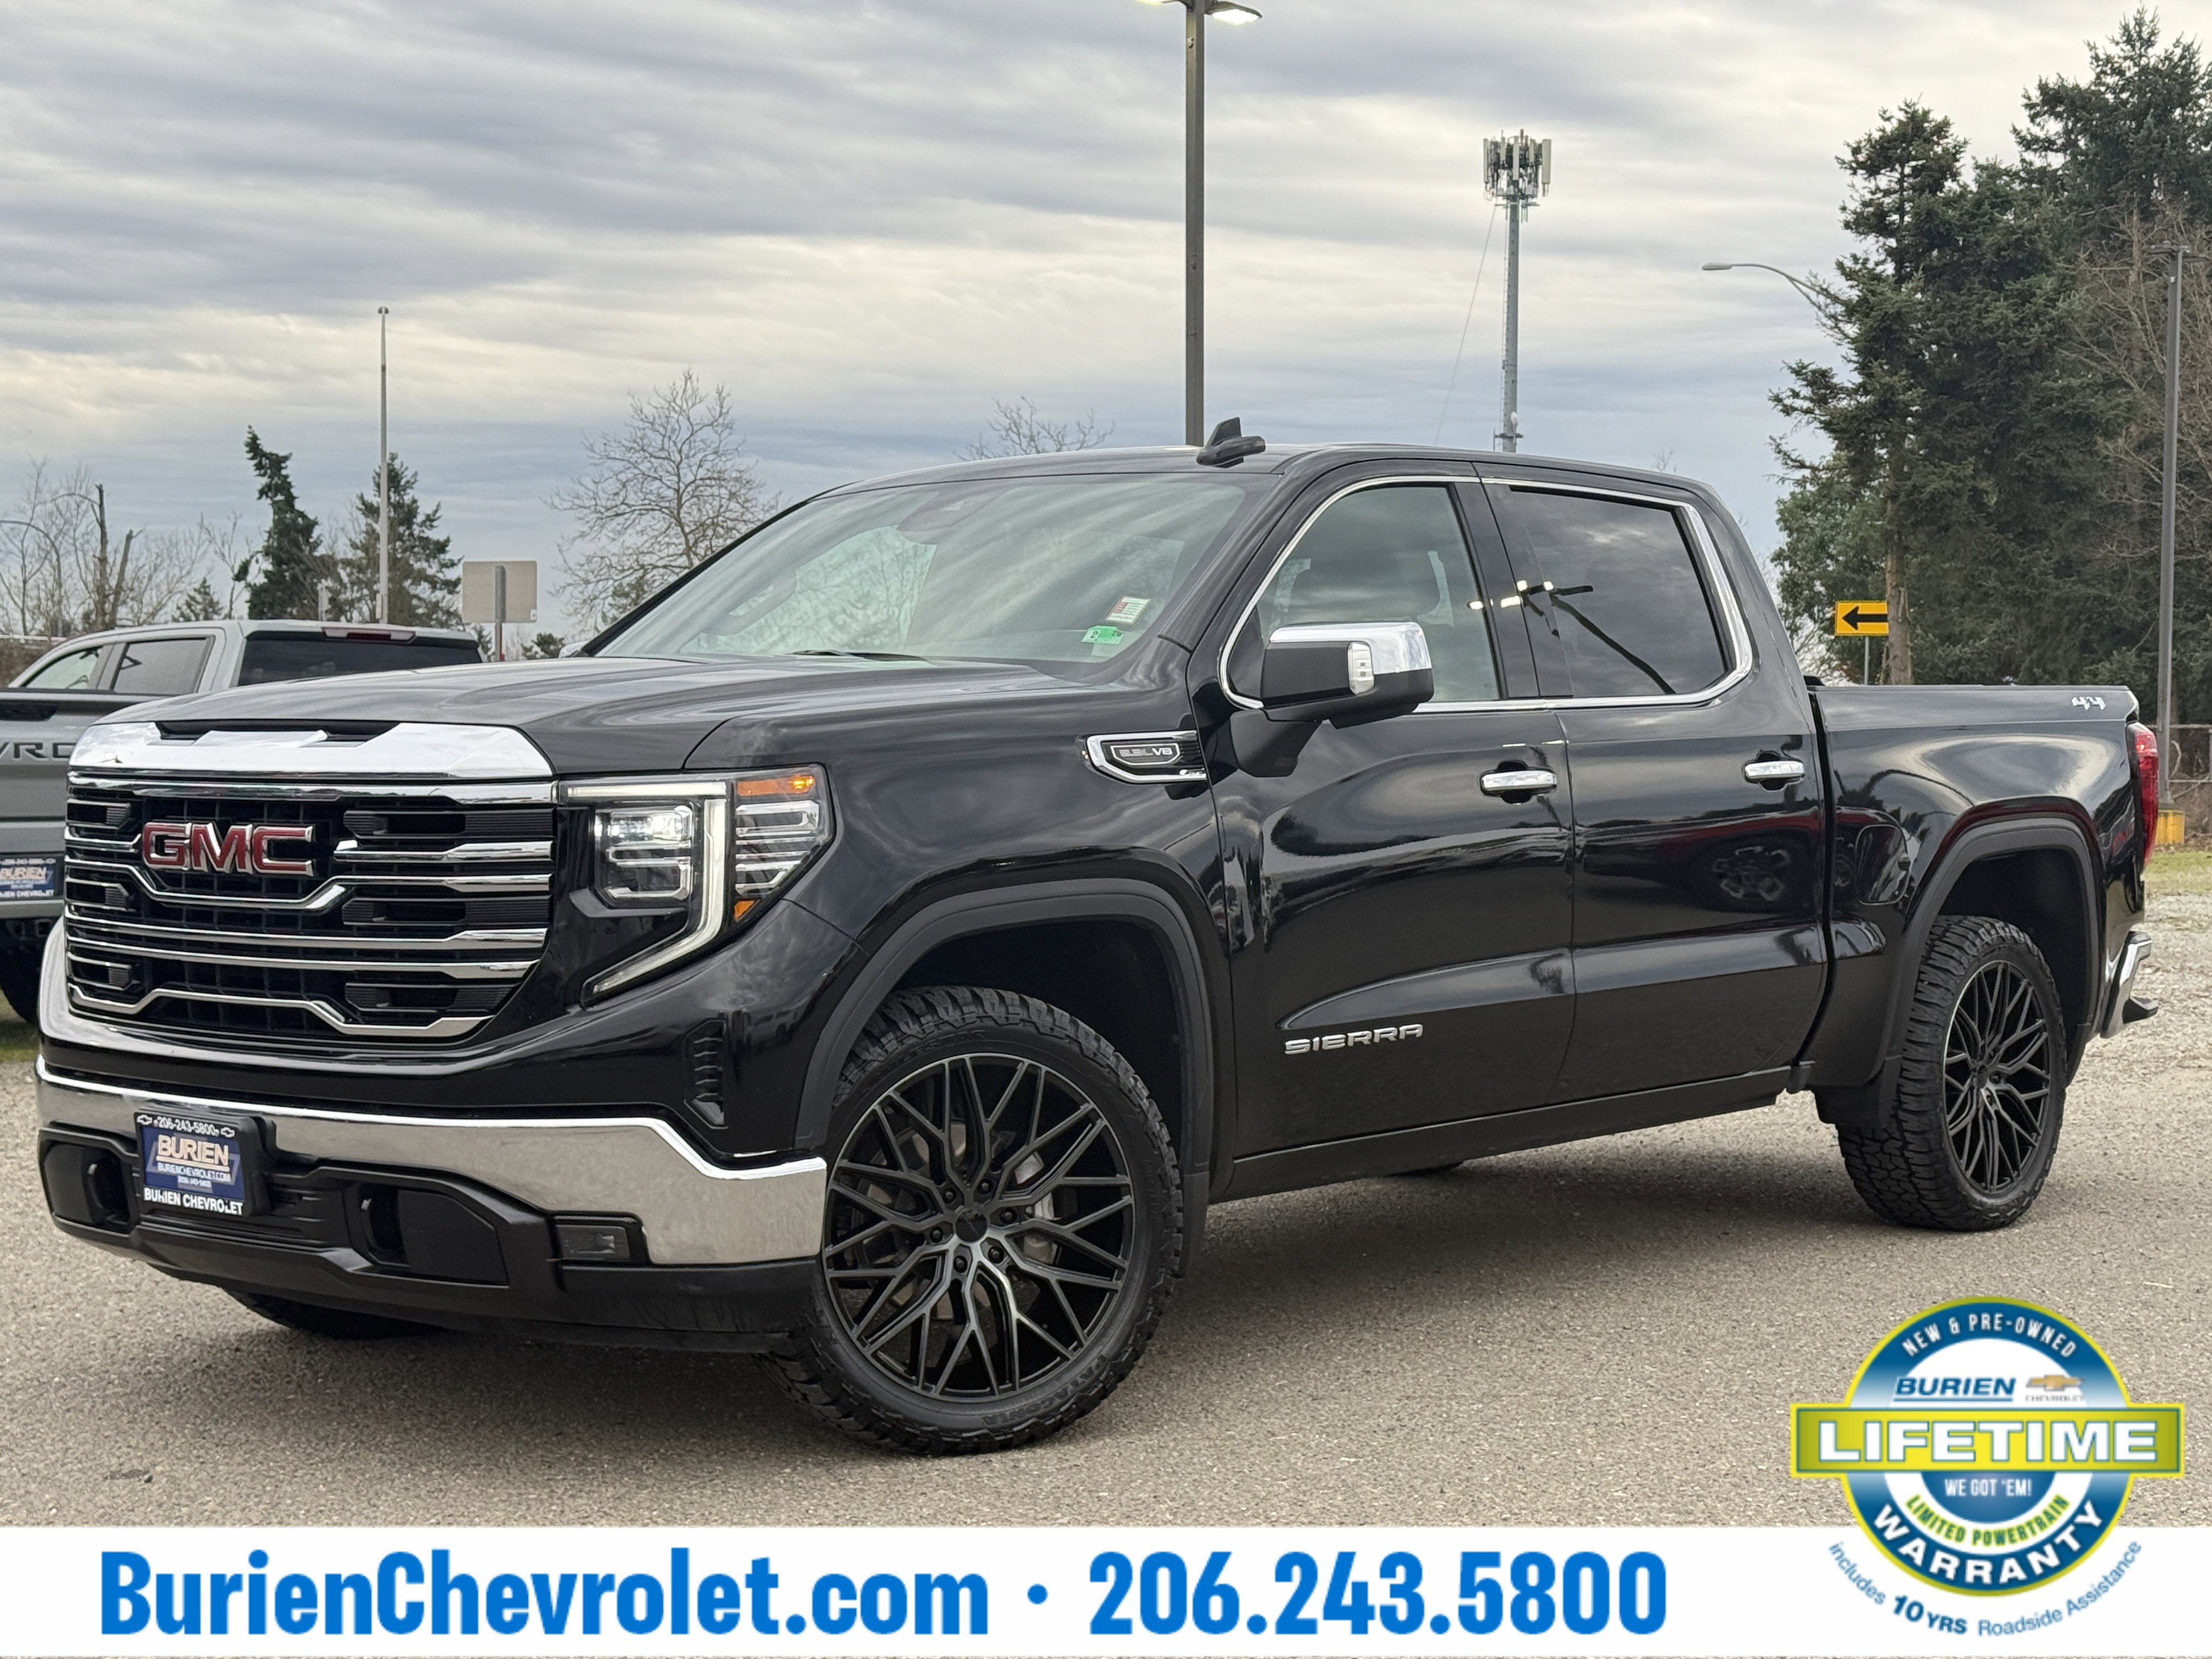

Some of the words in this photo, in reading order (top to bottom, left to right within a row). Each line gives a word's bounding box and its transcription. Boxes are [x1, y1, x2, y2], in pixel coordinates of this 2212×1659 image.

[142, 821, 314, 876] GMC
[1284, 1024, 1423, 1055] SIERRA
[158, 1134, 229, 1166] BURIEN
[143, 1187, 182, 1206] BURIEN
